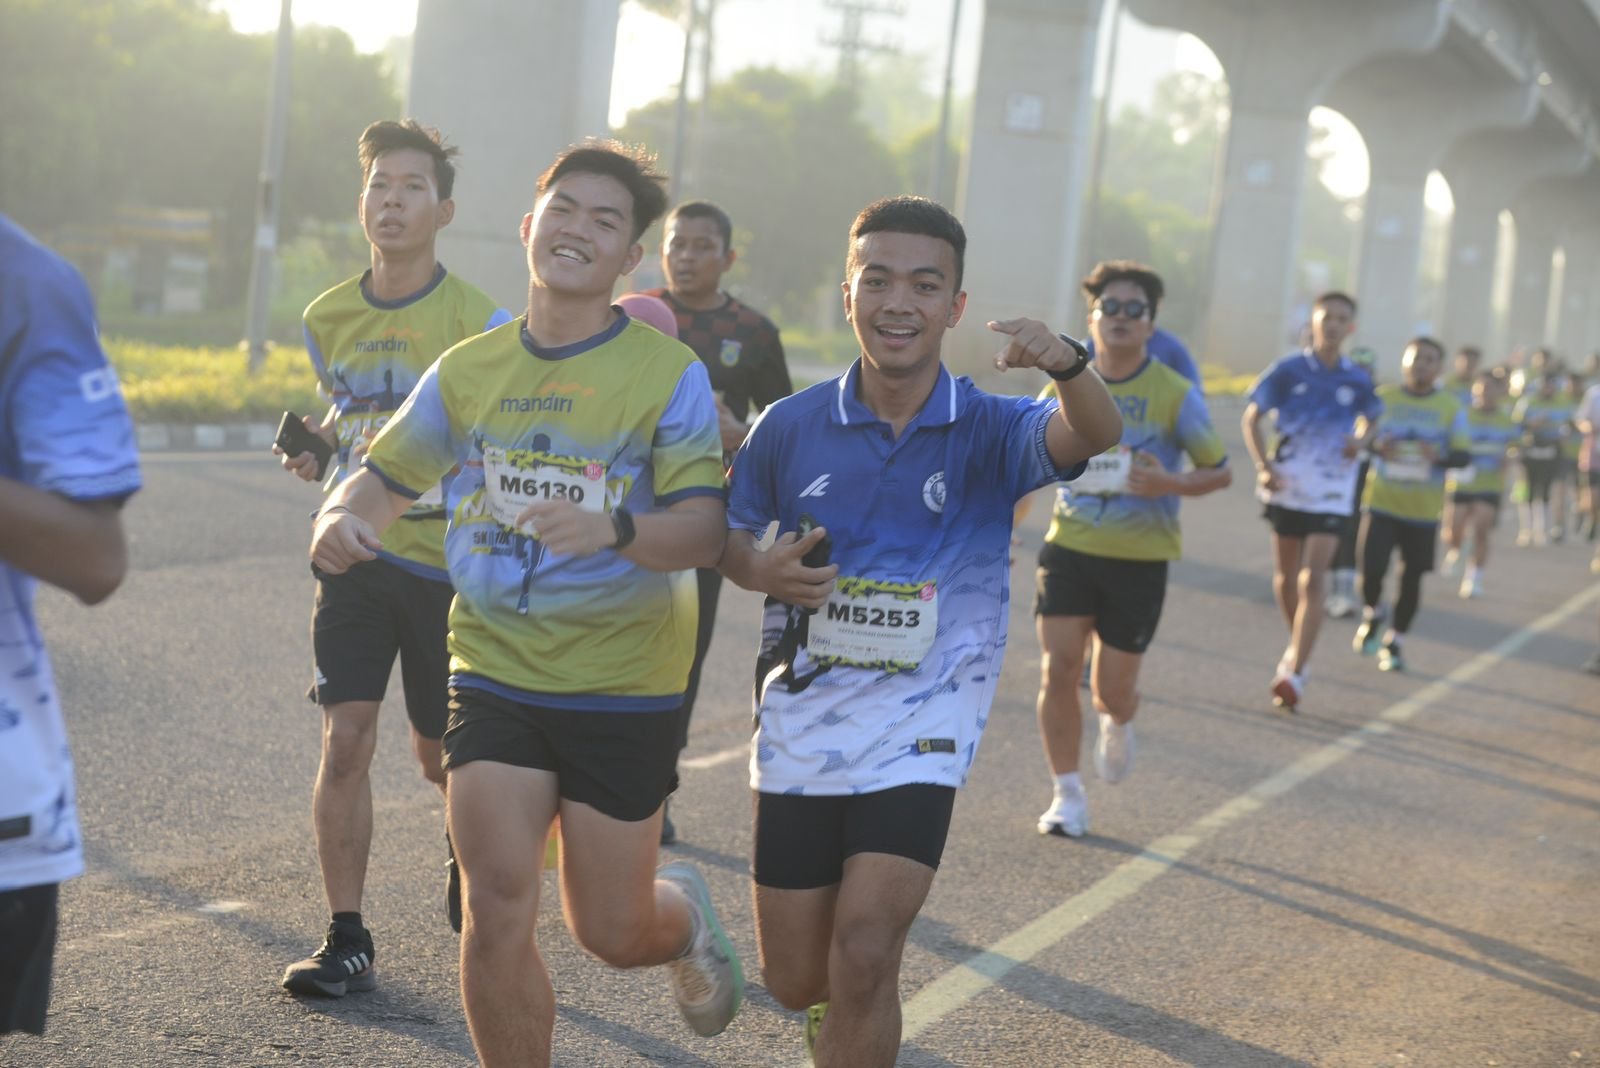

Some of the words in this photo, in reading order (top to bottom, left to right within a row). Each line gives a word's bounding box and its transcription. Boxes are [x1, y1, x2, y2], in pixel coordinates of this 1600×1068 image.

[355, 336, 408, 353] mandiri
[500, 391, 573, 413] mandiri
[500, 475, 585, 504] M6130
[827, 602, 920, 628] M5253
